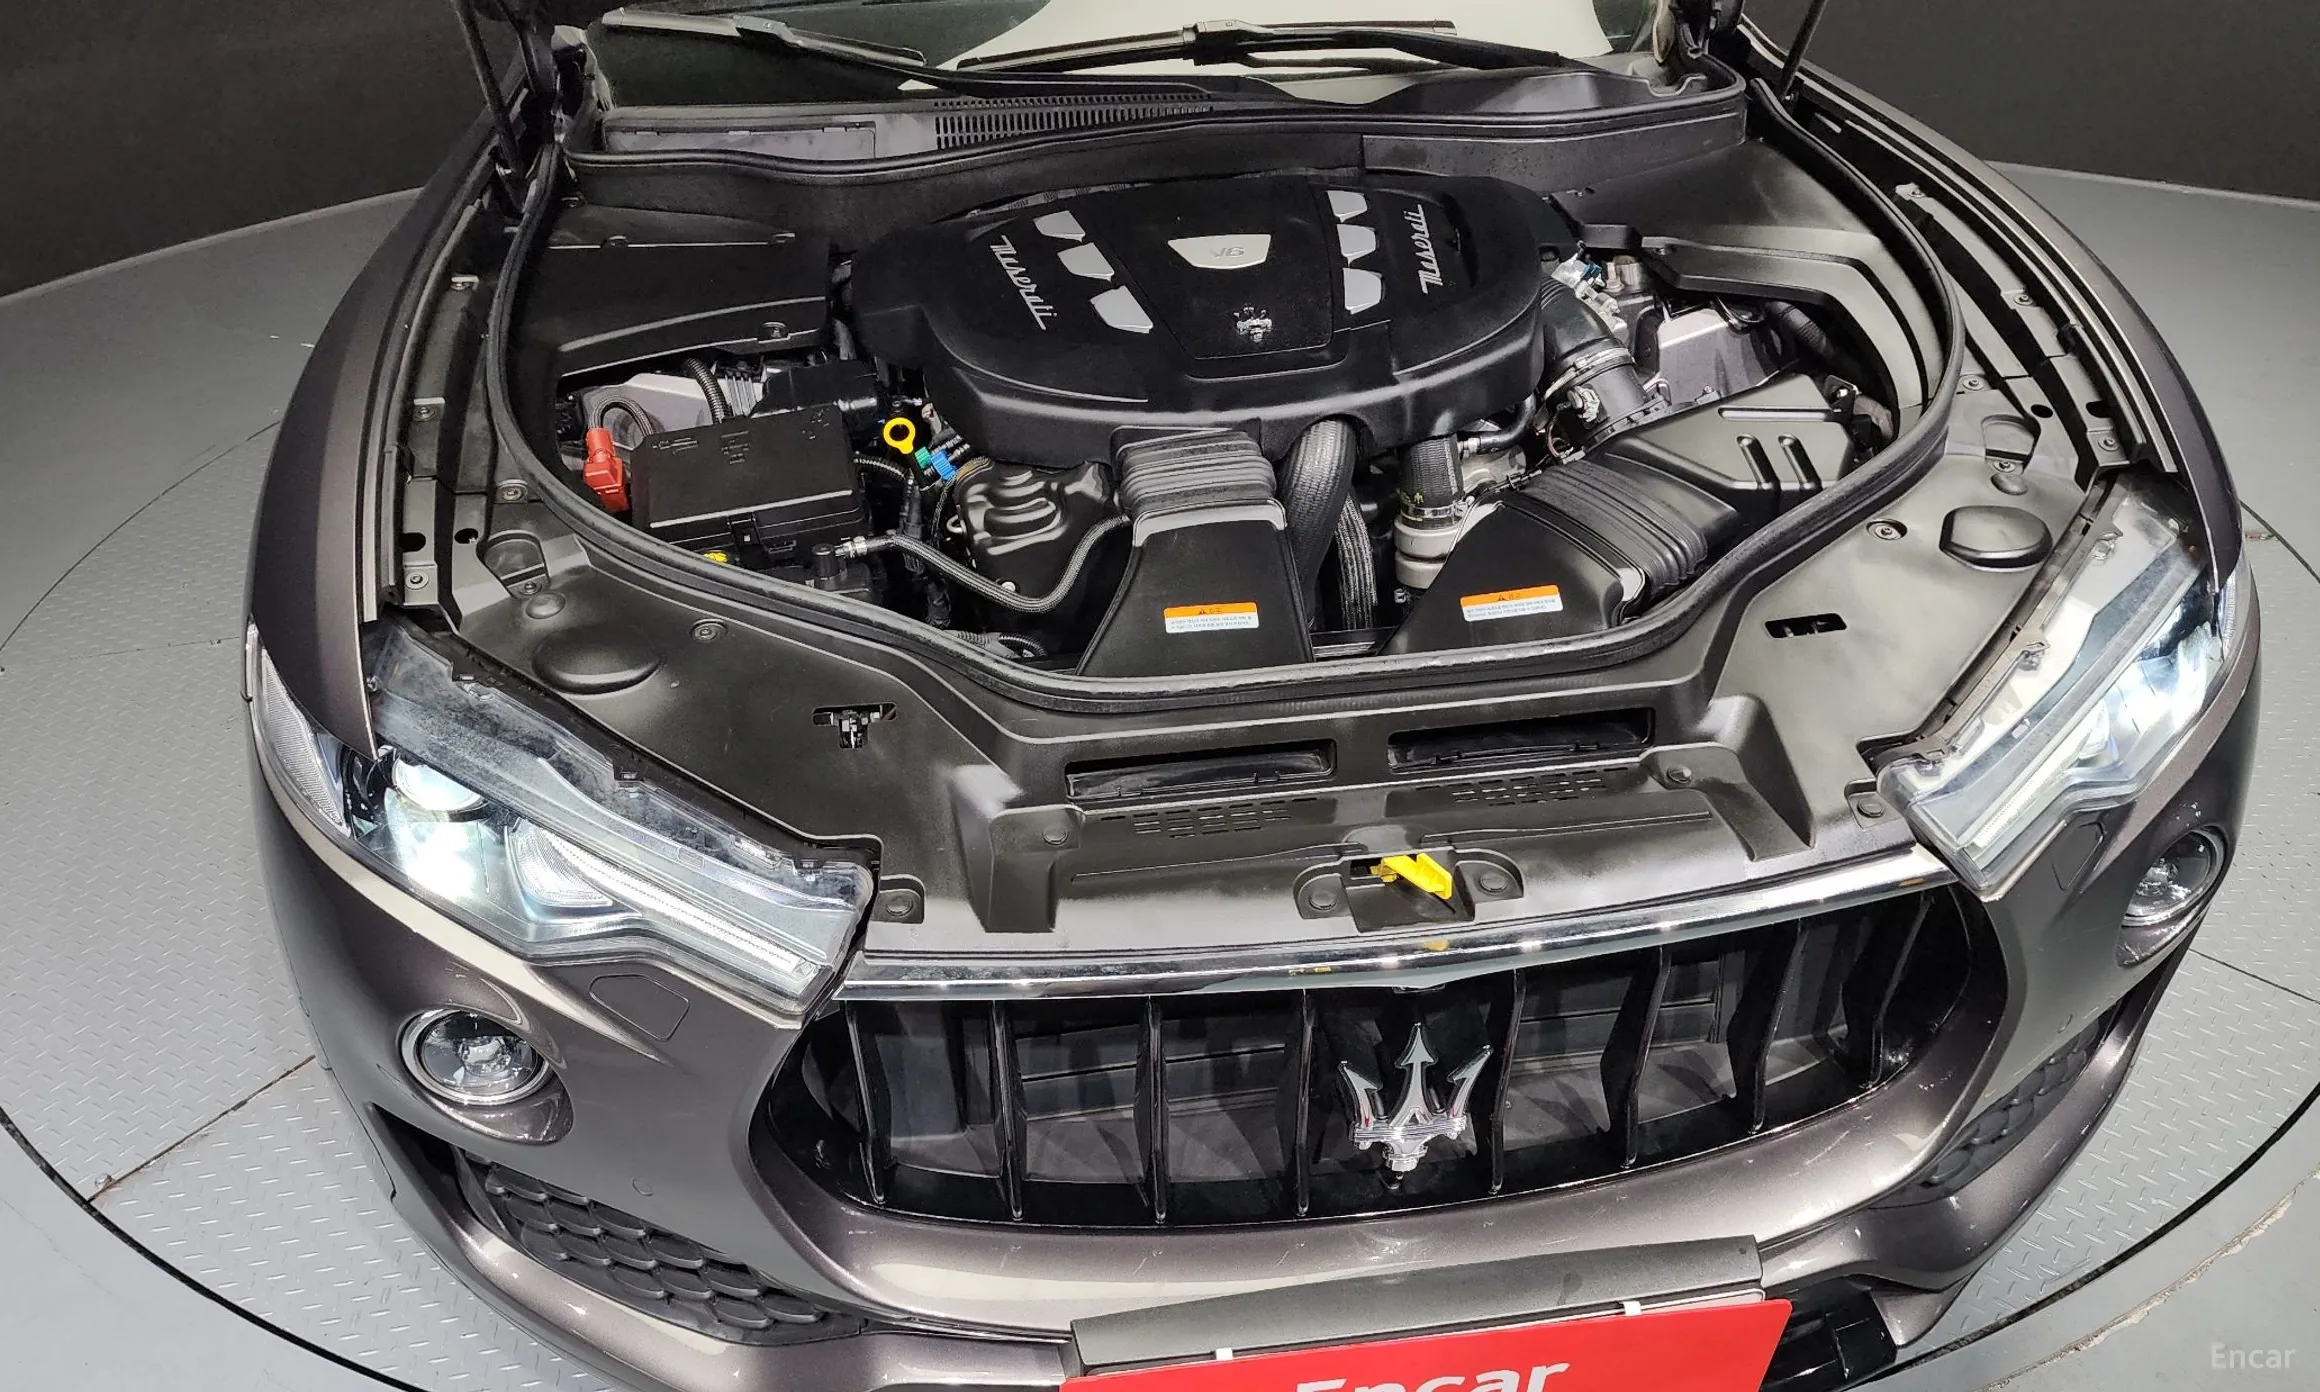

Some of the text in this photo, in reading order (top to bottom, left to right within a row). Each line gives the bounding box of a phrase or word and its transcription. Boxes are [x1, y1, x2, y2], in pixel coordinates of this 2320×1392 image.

[990, 234, 1057, 330] Maserati
[1208, 246, 1246, 258] V6
[1403, 203, 1443, 294] Maserati
